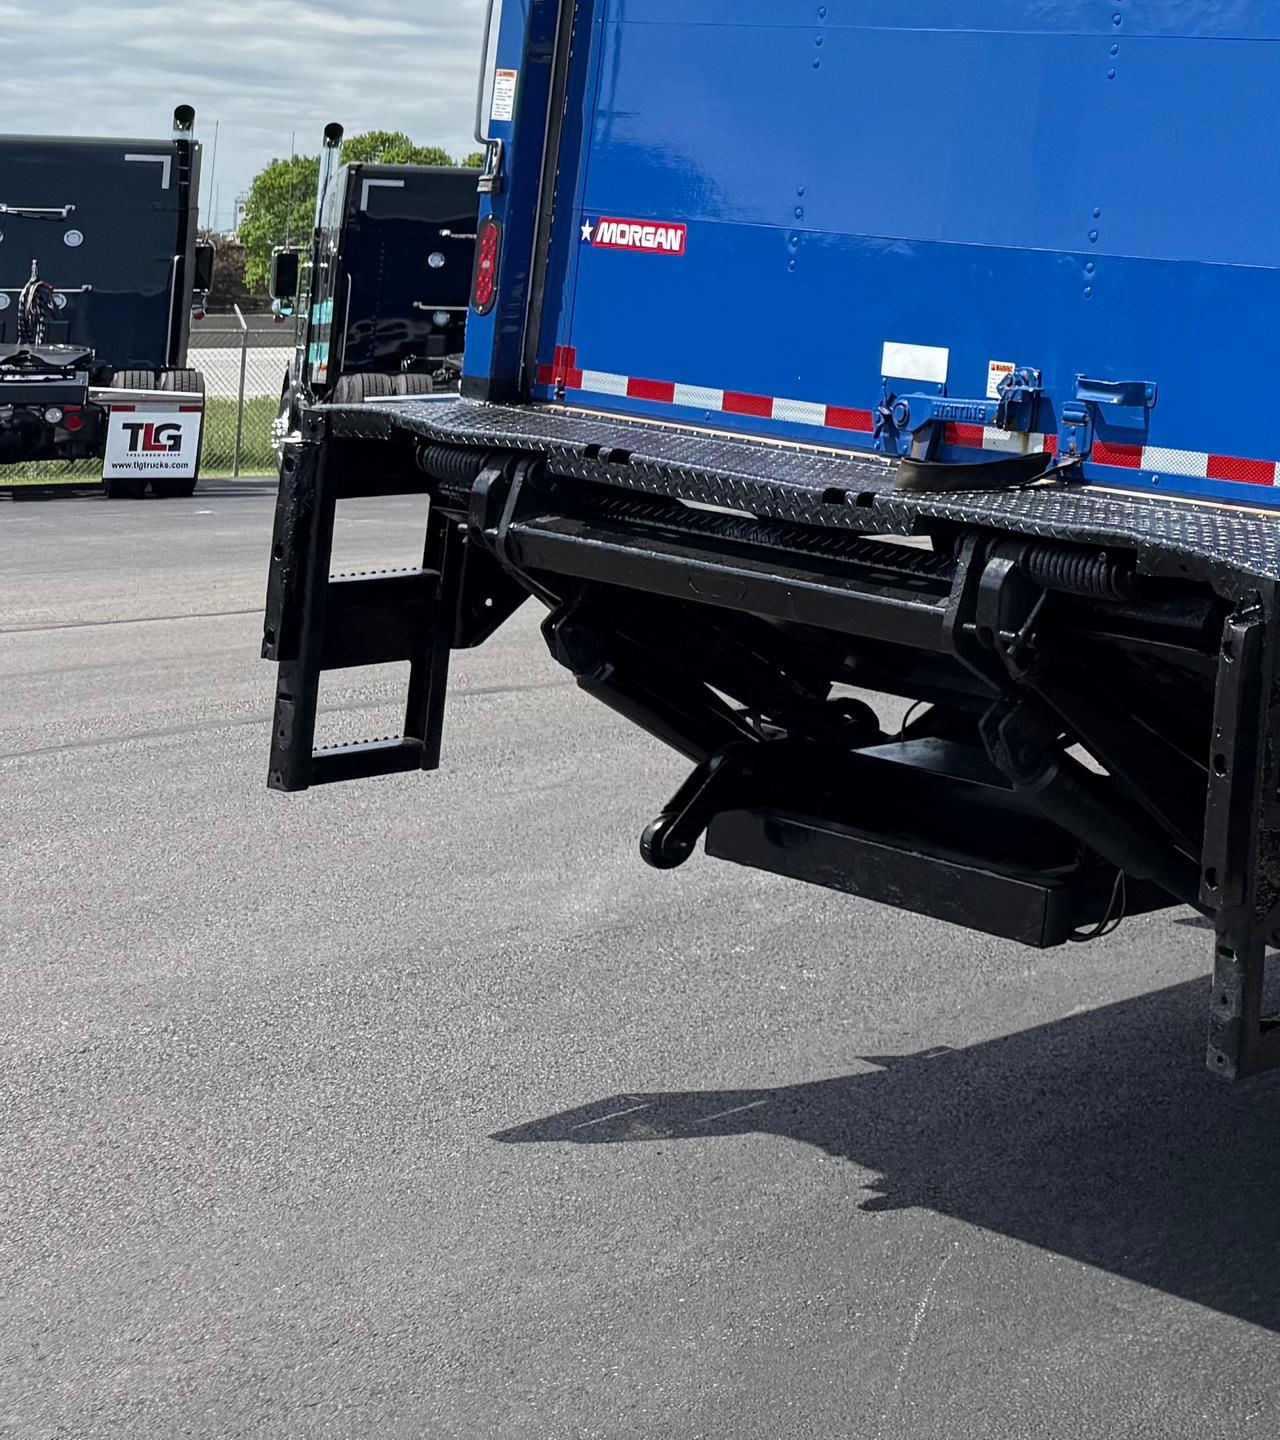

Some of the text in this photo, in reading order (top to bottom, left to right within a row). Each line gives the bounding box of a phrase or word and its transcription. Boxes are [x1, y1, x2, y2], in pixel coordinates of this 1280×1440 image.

[596, 222, 682, 251] MORGAN
[122, 423, 182, 452] TLG
[111, 461, 189, 471] www.tlgtrucks.com
